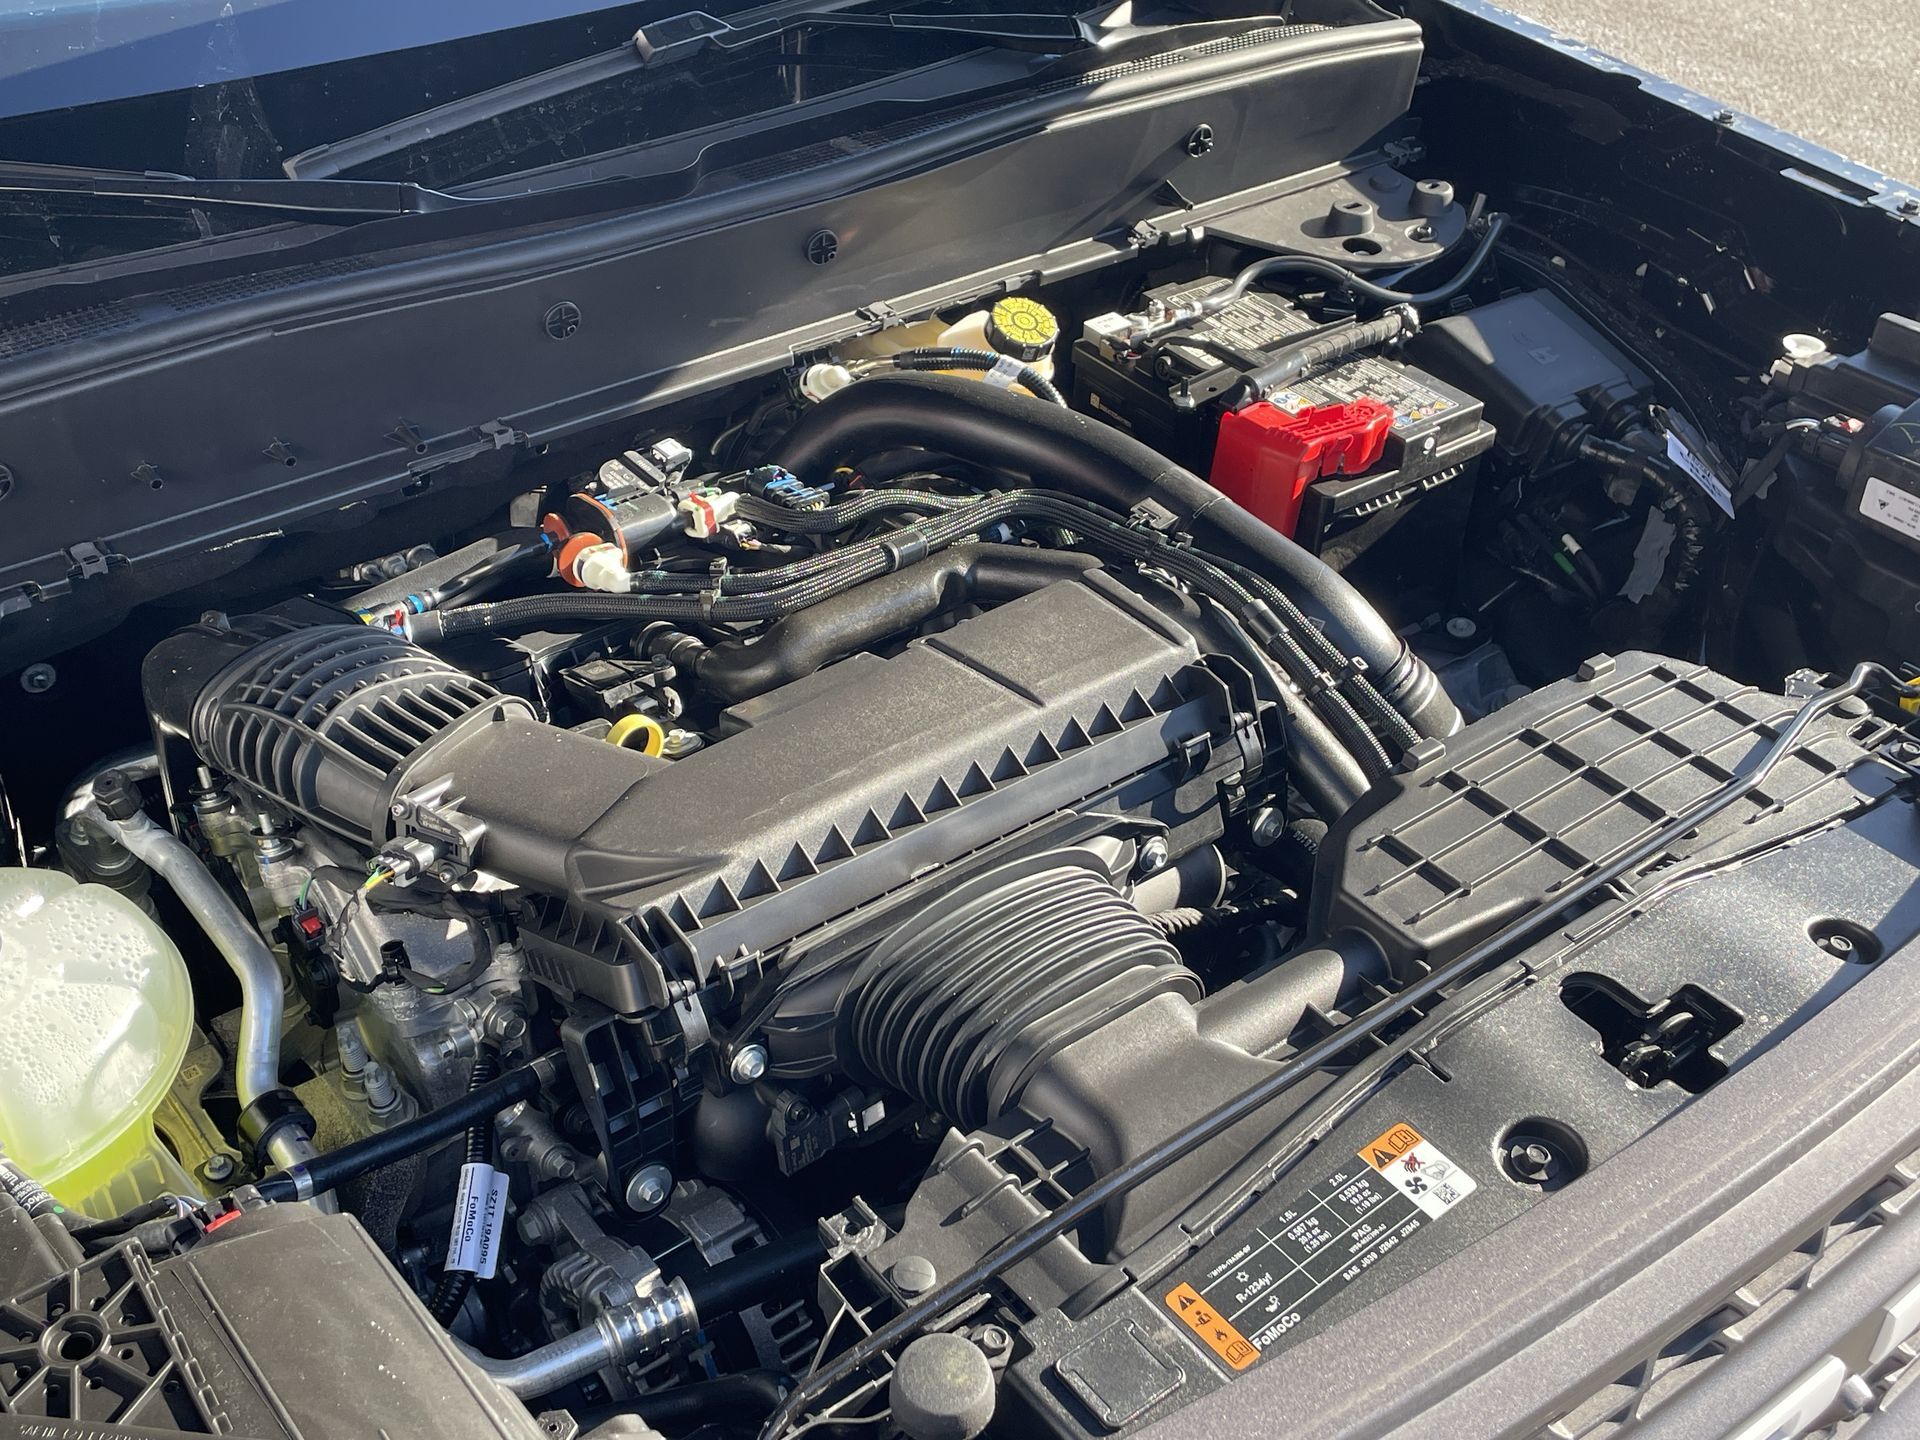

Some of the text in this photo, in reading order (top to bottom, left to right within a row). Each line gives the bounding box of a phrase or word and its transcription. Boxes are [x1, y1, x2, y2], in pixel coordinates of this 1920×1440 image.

[1329, 1173, 1348, 1187] 2.0L
[1356, 1179, 1369, 1189] kg
[464, 1196, 479, 1242] FoMoCo
[1279, 1210, 1298, 1224] 1.5L
[1305, 1217, 1319, 1228] kg
[1351, 1224, 1372, 1241] PAG
[1342, 1265, 1360, 1281] SAE
[1235, 1272, 1273, 1304] R-1234yf
[1251, 1312, 1301, 1351] FoMoCo
